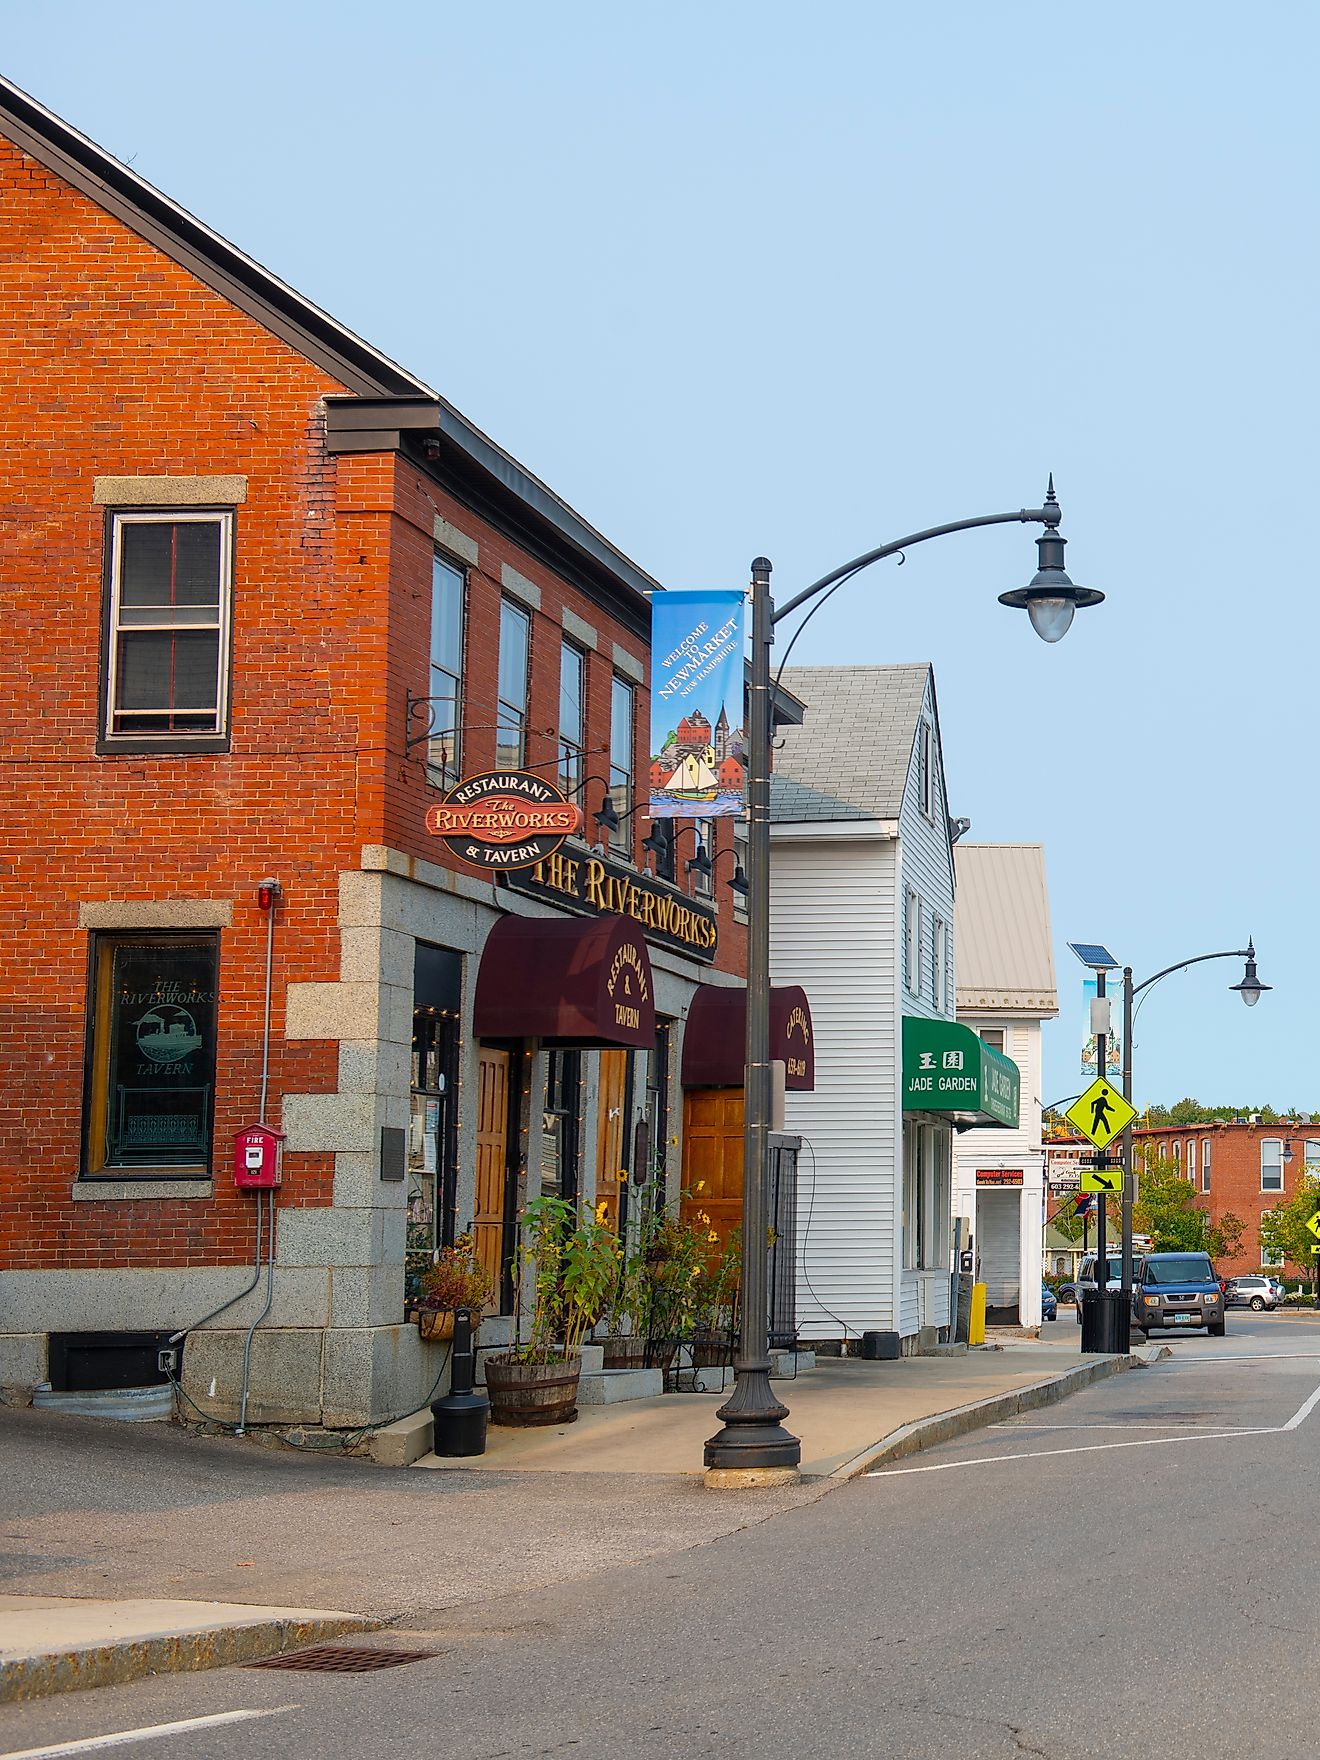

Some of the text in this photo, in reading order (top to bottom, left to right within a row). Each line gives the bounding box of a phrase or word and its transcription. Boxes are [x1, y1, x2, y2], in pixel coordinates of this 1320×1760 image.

[661, 622, 709, 668] WELCOME
[684, 644, 699, 659] TO
[658, 618, 739, 700] NEWMARKET
[680, 640, 738, 698] NEW HAMPSHIRE
[456, 777, 552, 803] RESTAURANT
[485, 800, 515, 811] The
[435, 810, 570, 830] RIVERWORKS
[466, 843, 541, 863] & TAVERN
[584, 858, 710, 949] RIVERWORKS
[607, 943, 648, 1003] RESTAURANT
[154, 981, 182, 992] THE
[624, 975, 631, 995] &
[120, 992, 215, 1005] RIVERWORKS
[615, 1003, 639, 1029] TAVERN
[136, 1063, 194, 1075] TAVERN
[908, 1078, 977, 1091] JADE GARDEN
[976, 1170, 1023, 1179] Computer Services
